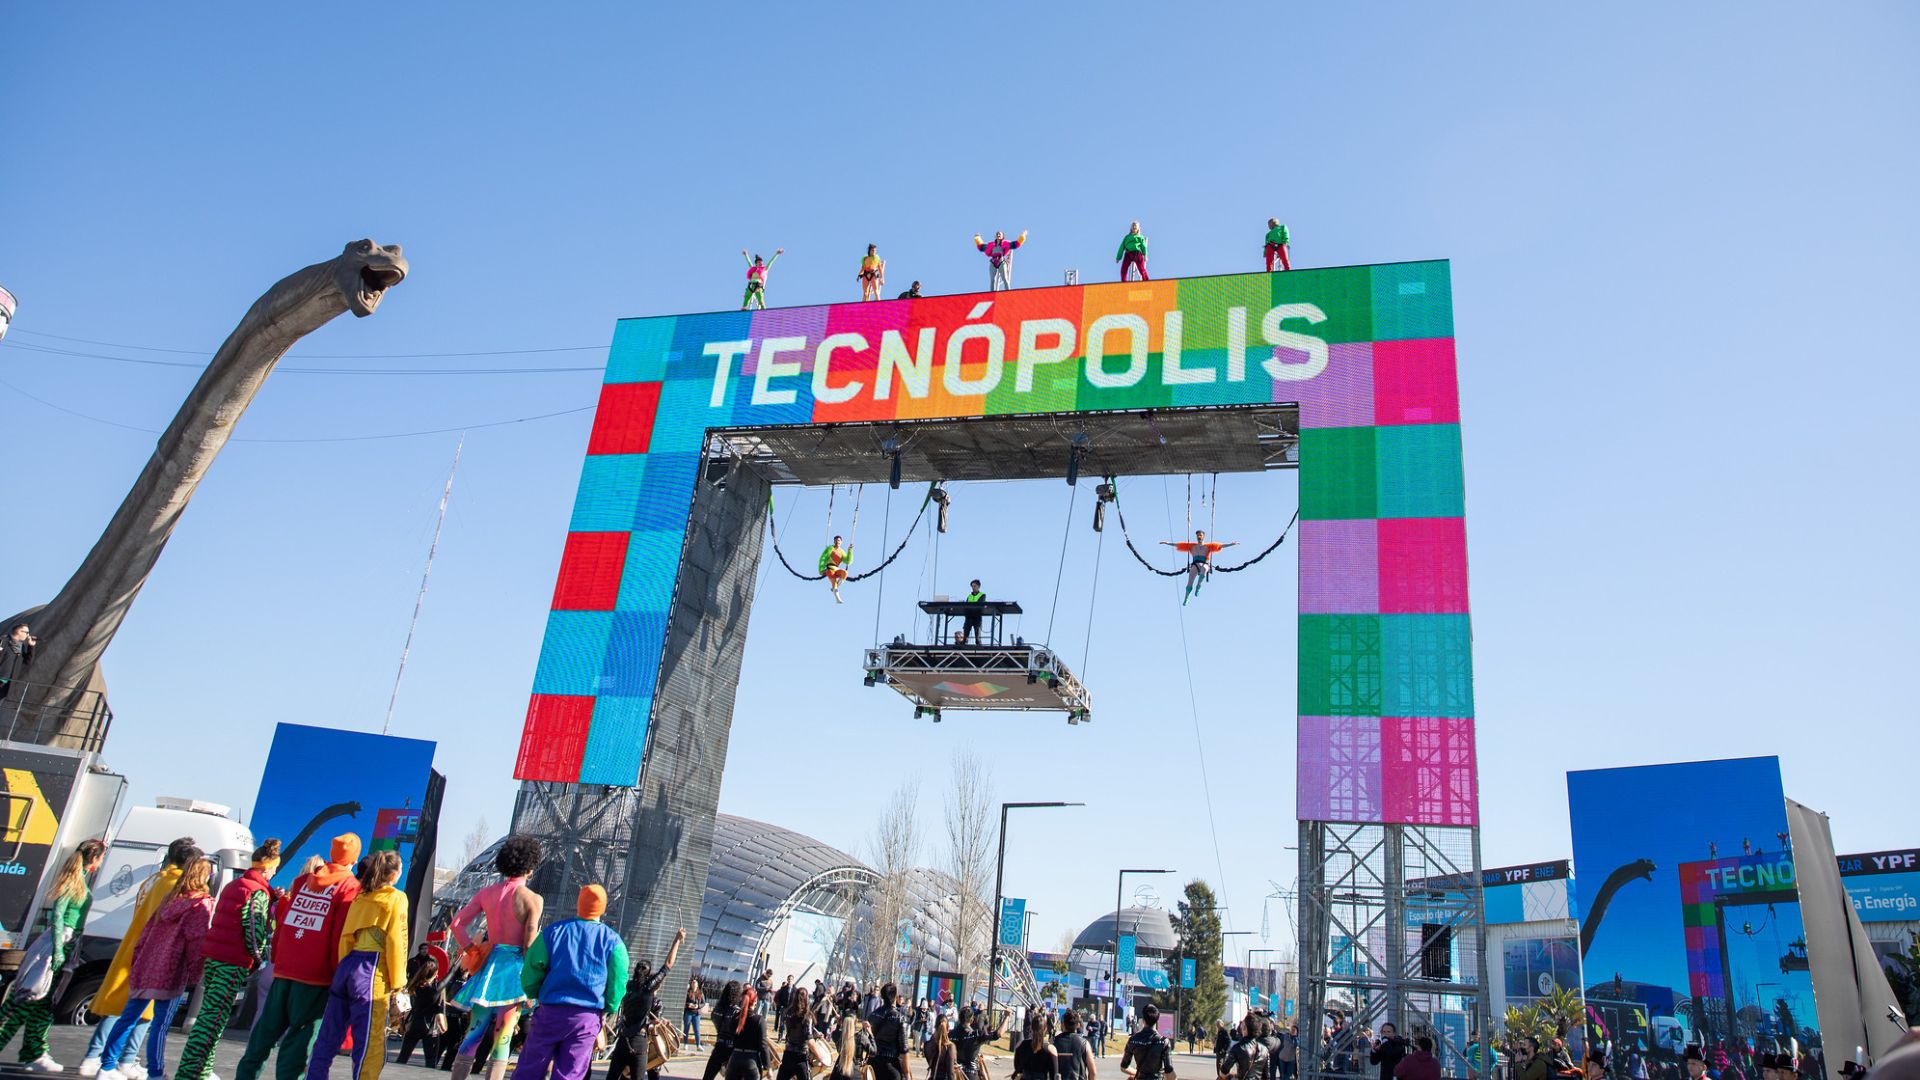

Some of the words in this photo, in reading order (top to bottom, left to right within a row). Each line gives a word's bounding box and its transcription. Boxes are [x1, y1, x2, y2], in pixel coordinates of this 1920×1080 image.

[702, 300, 1330, 408] TECNÓPOLIS
[396, 815, 418, 831] TE
[1872, 853, 1916, 870] YPF
[1505, 868, 1531, 882] YPF
[1705, 854, 1796, 890] TECNÓ
[294, 897, 329, 913] SUPER
[1864, 892, 1917, 912] Energía
[293, 914, 317, 928] FAN
